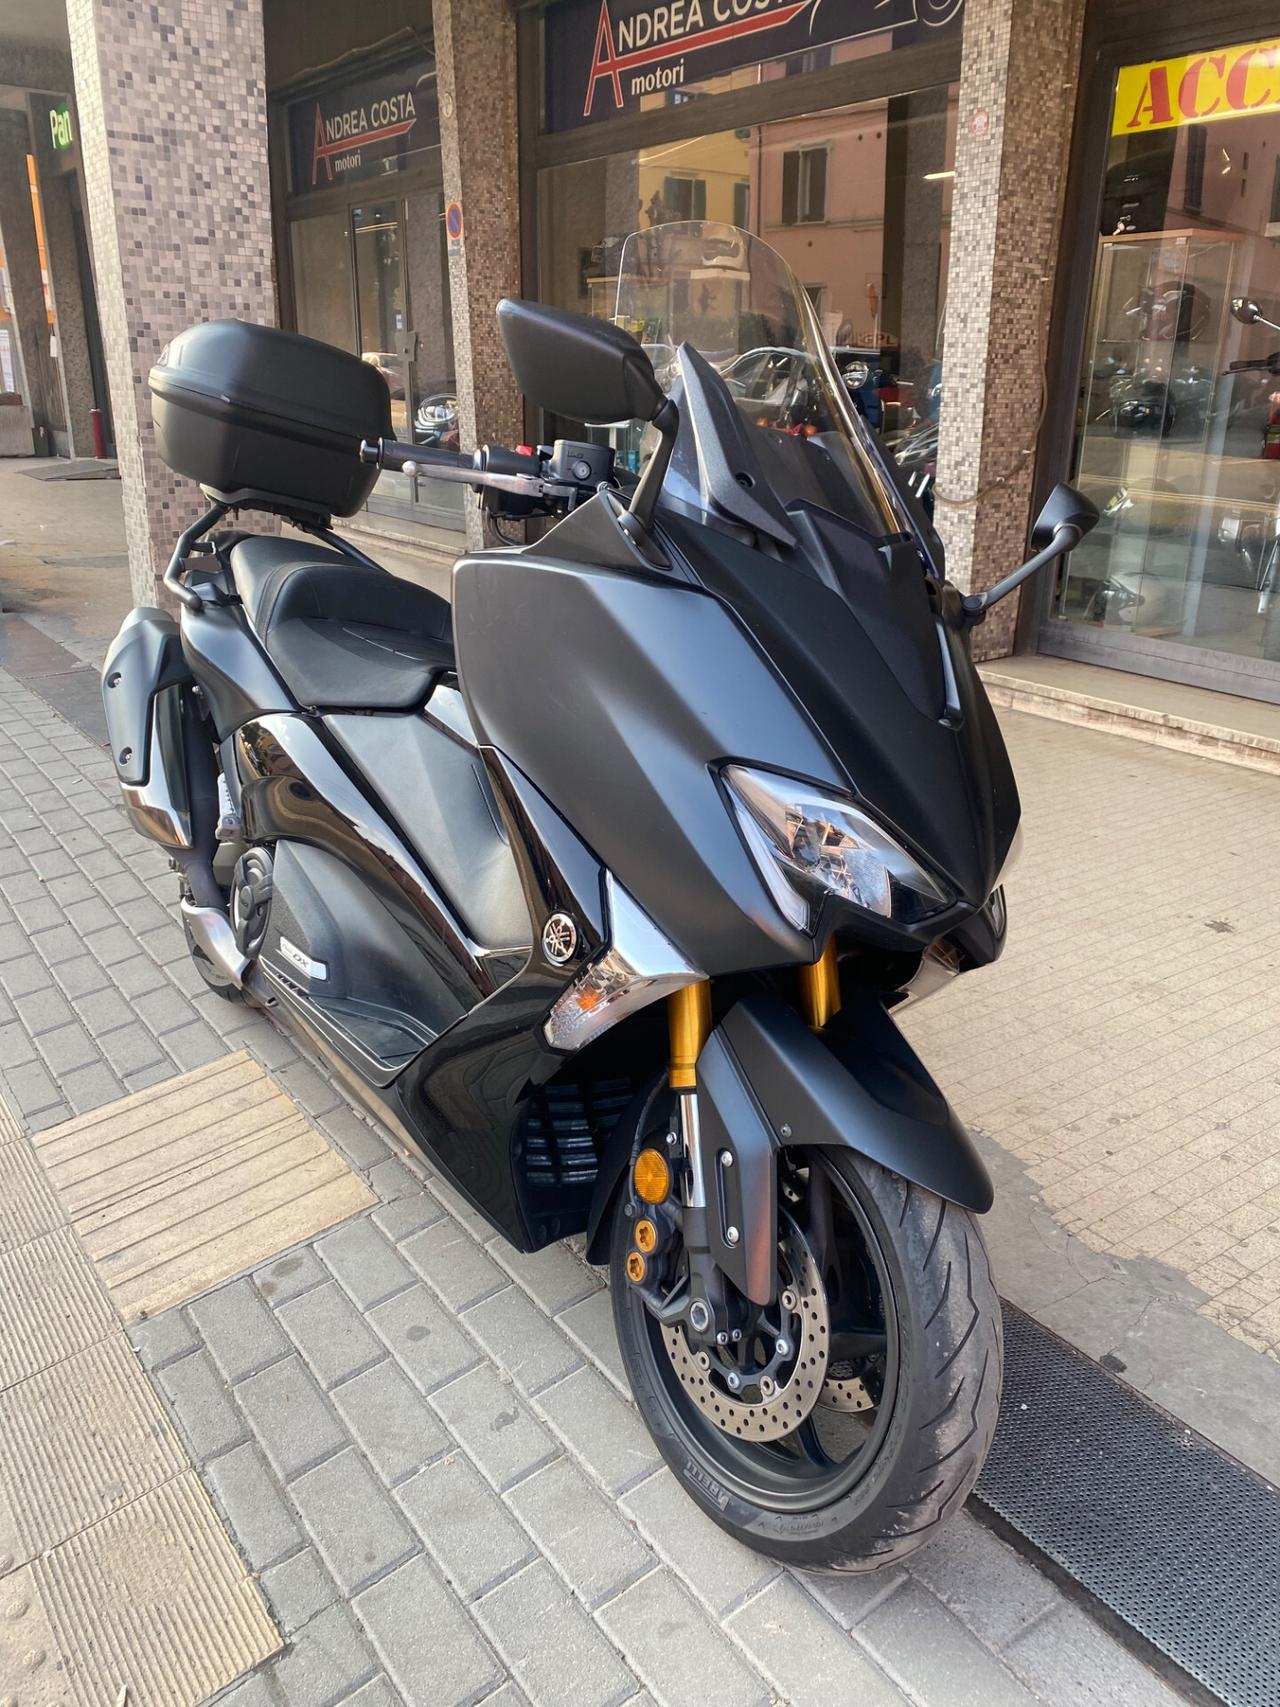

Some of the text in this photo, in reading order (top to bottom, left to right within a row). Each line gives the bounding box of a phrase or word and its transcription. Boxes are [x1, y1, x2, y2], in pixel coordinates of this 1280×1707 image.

[584, 0, 704, 117] ANDREA
[631, 58, 685, 96] motori
[1127, 46, 1280, 127] ACC
[50, 109, 73, 149] Pan
[312, 91, 416, 184] ANDREA COSTA
[335, 149, 361, 172] motori
[682, 1459, 730, 1512] PIRELLI
